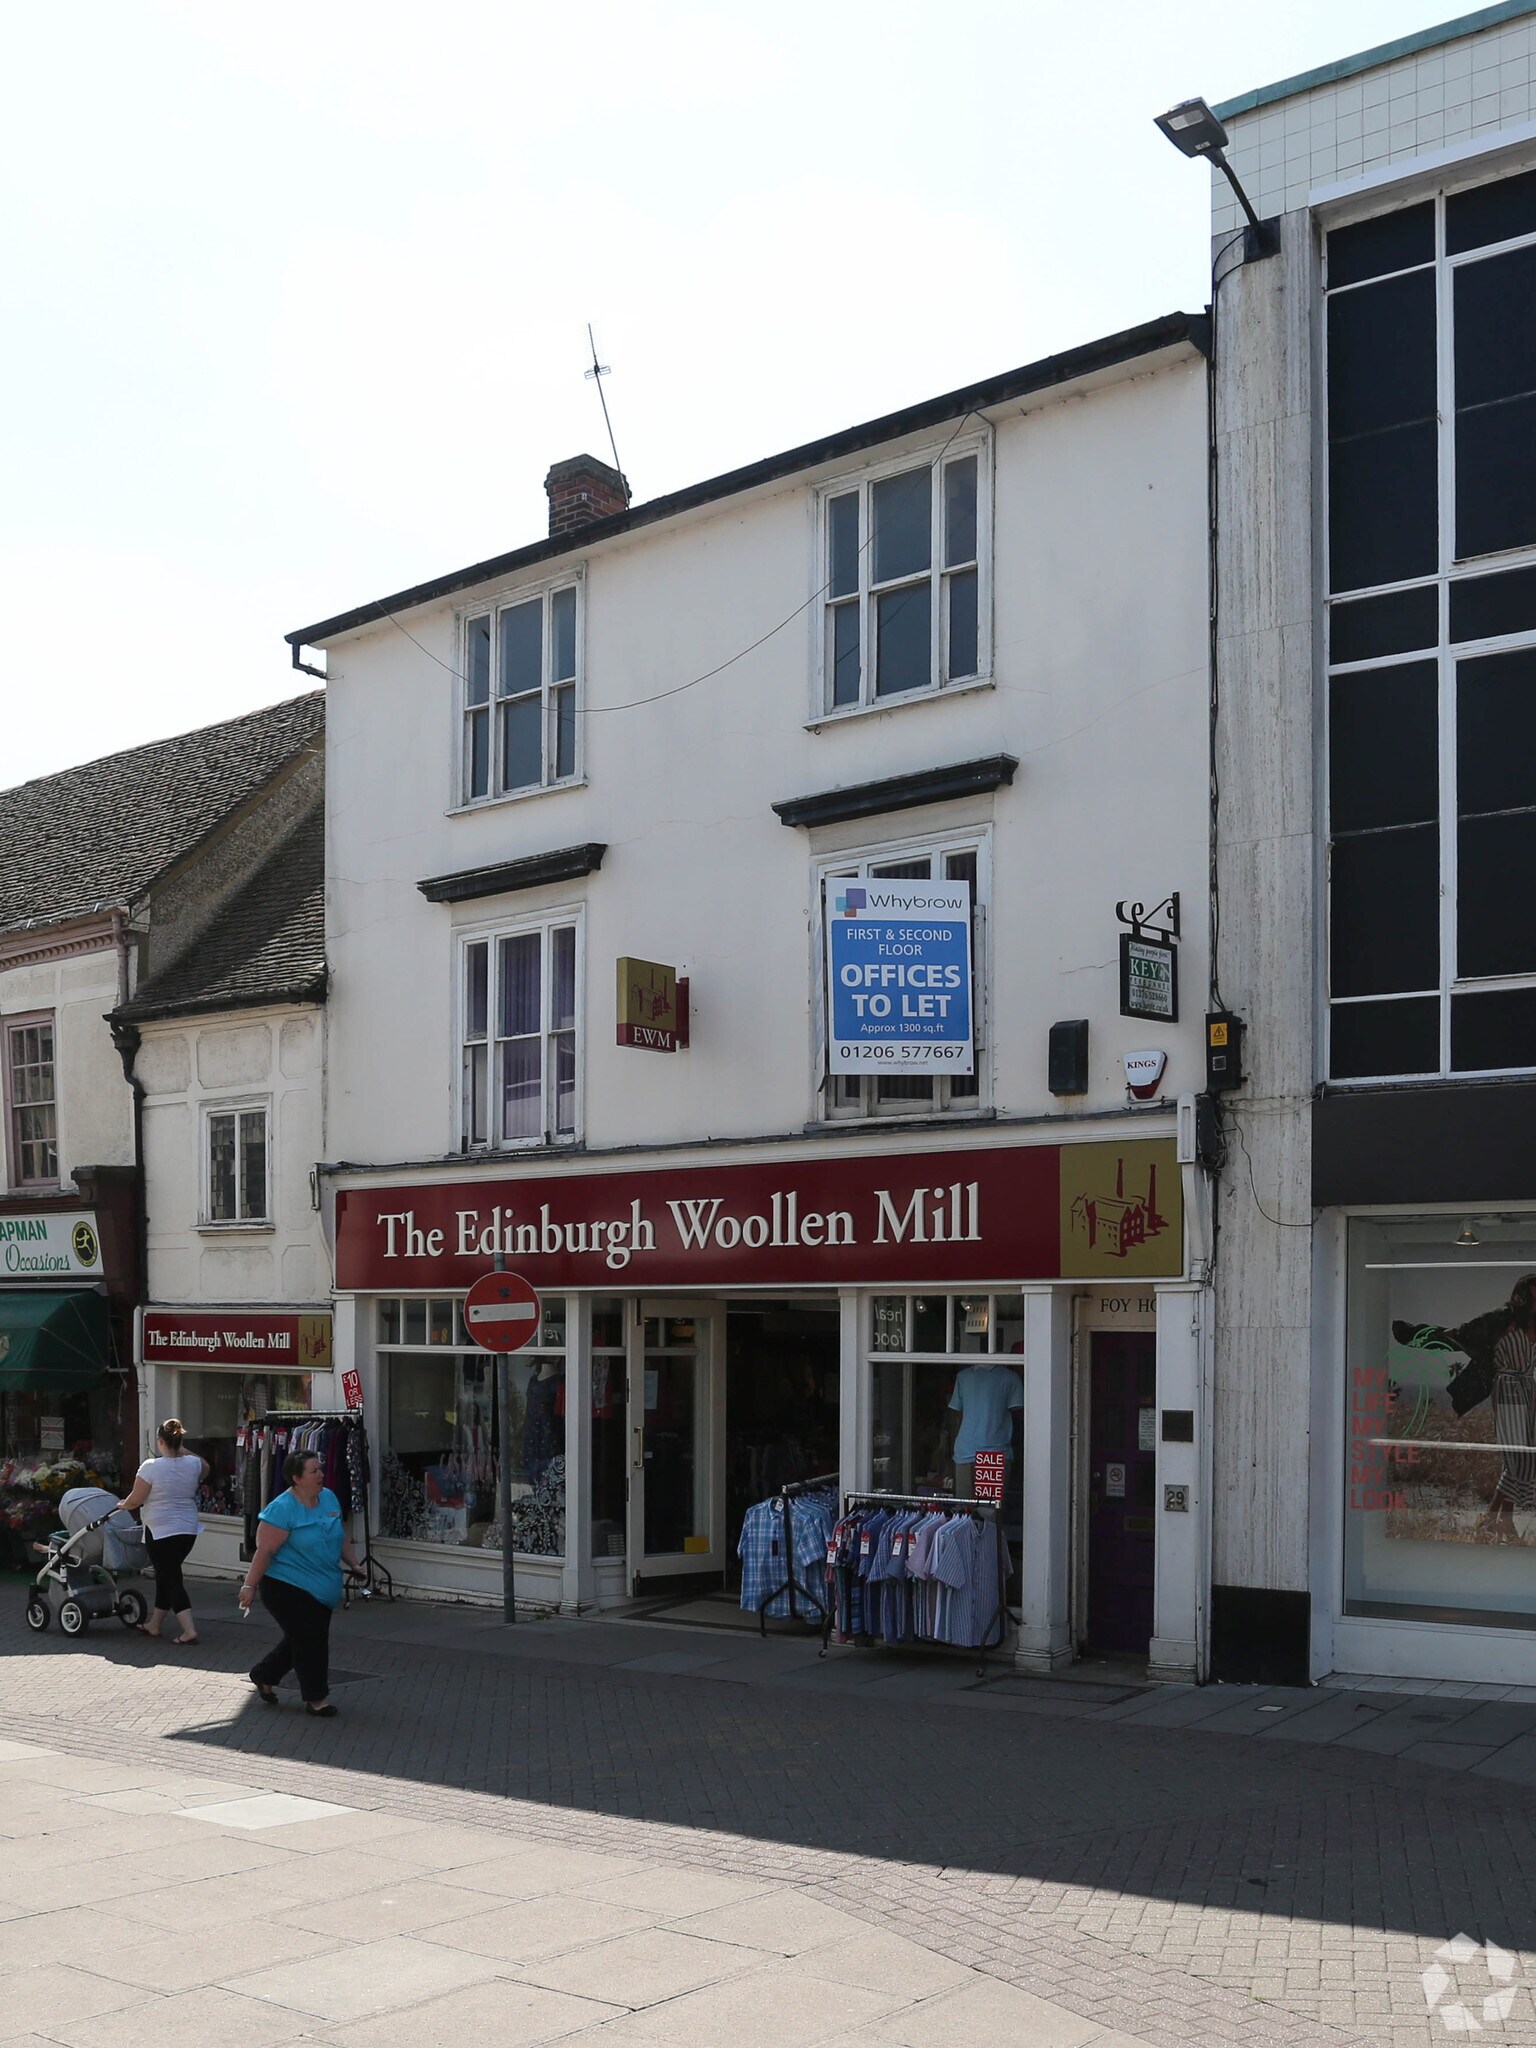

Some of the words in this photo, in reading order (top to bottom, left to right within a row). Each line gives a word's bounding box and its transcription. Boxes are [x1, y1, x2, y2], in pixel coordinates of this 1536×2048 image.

[870, 894, 963, 911] Whybrow
[847, 929, 881, 940] FIRST
[885, 929, 895, 941] &
[899, 929, 952, 941] SECOND
[878, 944, 922, 956] FLOOR
[840, 964, 961, 988] OFFICES
[1130, 958, 1158, 978] KEY
[852, 994, 892, 1018] TO
[902, 994, 952, 1018] LET
[633, 1026, 671, 1048] EWM
[860, 1023, 896, 1034] Approx
[899, 1023, 921, 1033] 1300
[923, 1023, 944, 1034] sq.ft
[840, 1046, 895, 1059] 01206
[901, 1046, 964, 1059] 577667
[1127, 1060, 1157, 1069] KINGS
[0, 1220, 47, 1241] APMAN
[377, 1211, 444, 1258] The
[454, 1199, 657, 1270] Edinburgh
[666, 1191, 857, 1249] Woollen
[873, 1182, 983, 1243] Mill
[6, 1244, 71, 1272] Occasions
[1100, 1299, 1131, 1313] FOY
[148, 1330, 168, 1346] The
[170, 1331, 221, 1352] Edinburgh
[223, 1331, 265, 1348] Woollen
[267, 1332, 290, 1349] Mill
[343, 1371, 358, 1387] £10
[1353, 1367, 1388, 1388] MY
[347, 1394, 363, 1407] LESS
[349, 1388, 358, 1397] OR
[1353, 1391, 1397, 1414] LIFE
[1352, 1416, 1386, 1436] MY
[975, 1453, 1003, 1465] SALE
[1351, 1440, 1421, 1463] STYLE
[975, 1469, 1003, 1481] SALE
[1351, 1464, 1386, 1484] MY
[974, 1486, 1002, 1498] SALE
[1167, 1490, 1185, 1505] 29
[1350, 1488, 1409, 1510] LOOK
